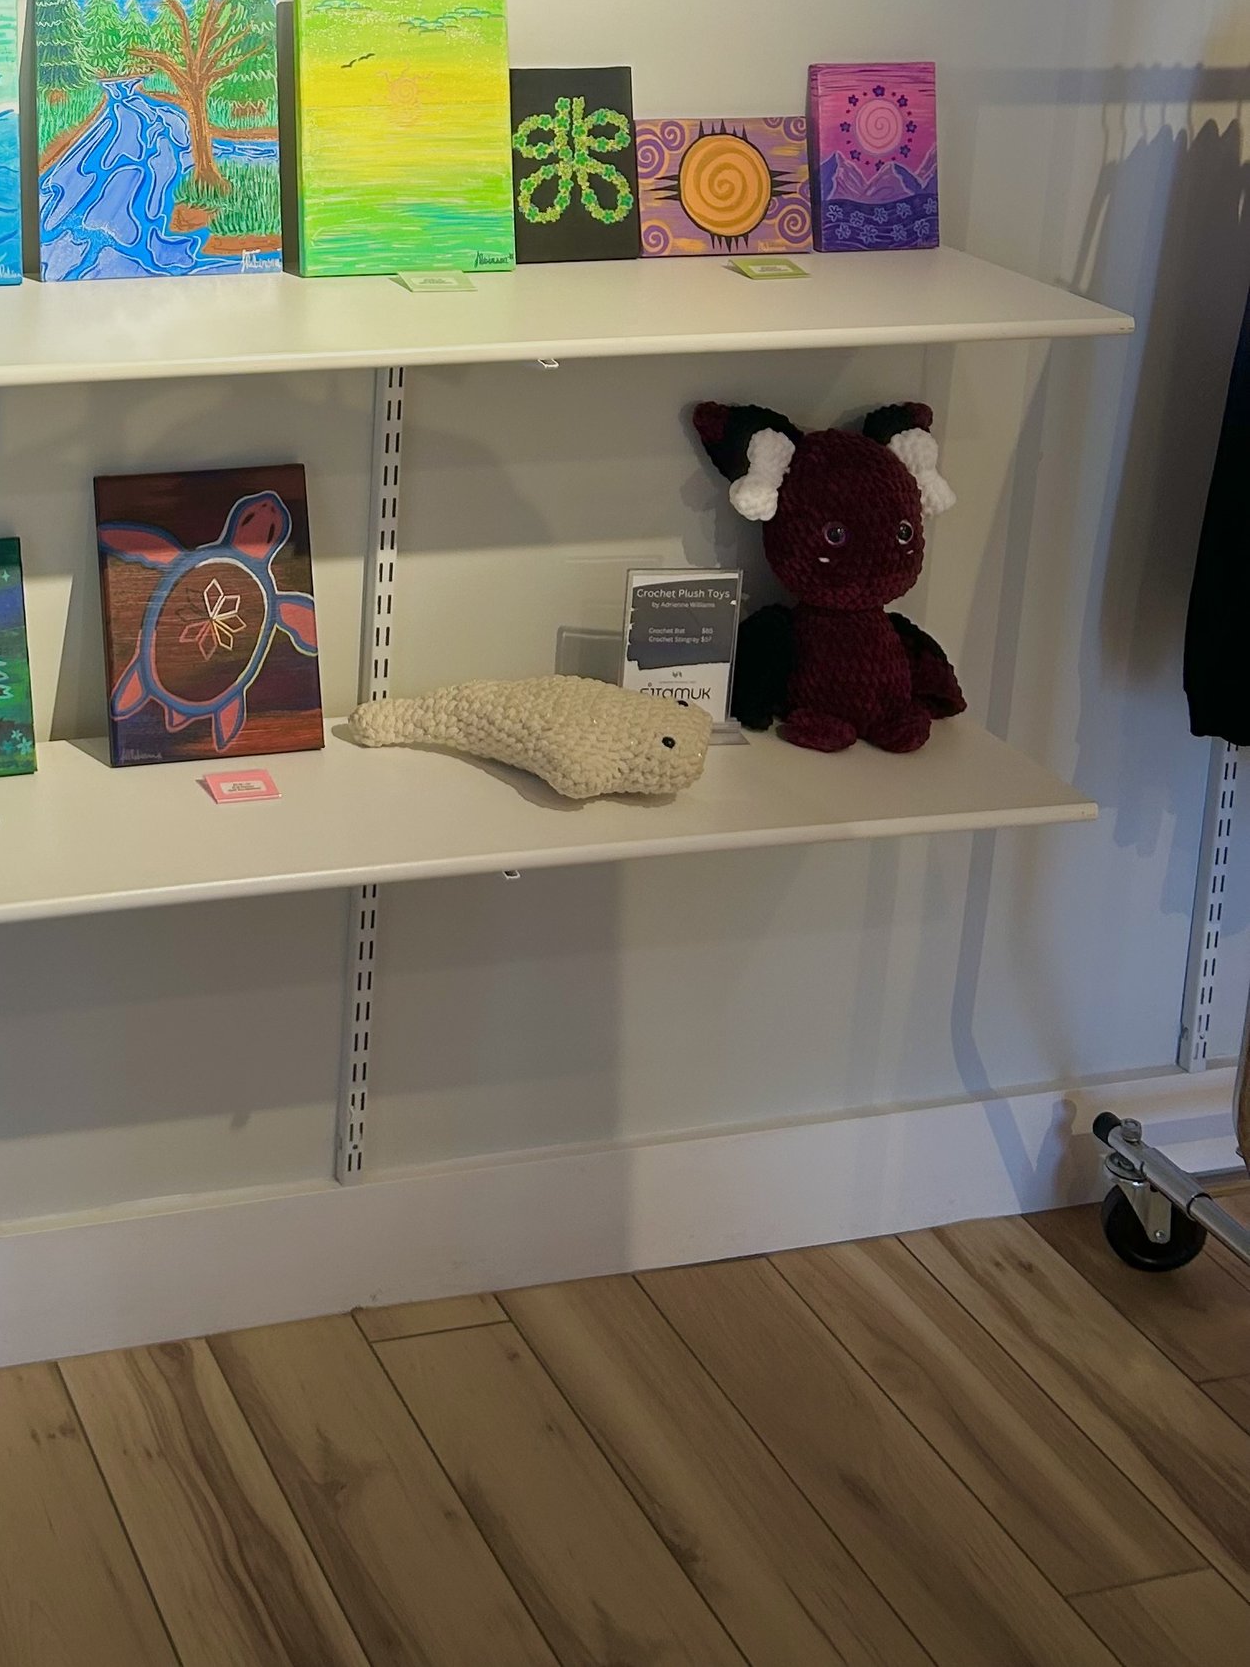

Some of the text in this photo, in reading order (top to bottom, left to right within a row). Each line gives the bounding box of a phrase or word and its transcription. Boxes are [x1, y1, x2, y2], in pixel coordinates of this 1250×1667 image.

[636, 588, 730, 600] Crochet Plush Toys
[651, 601, 659, 609] by
